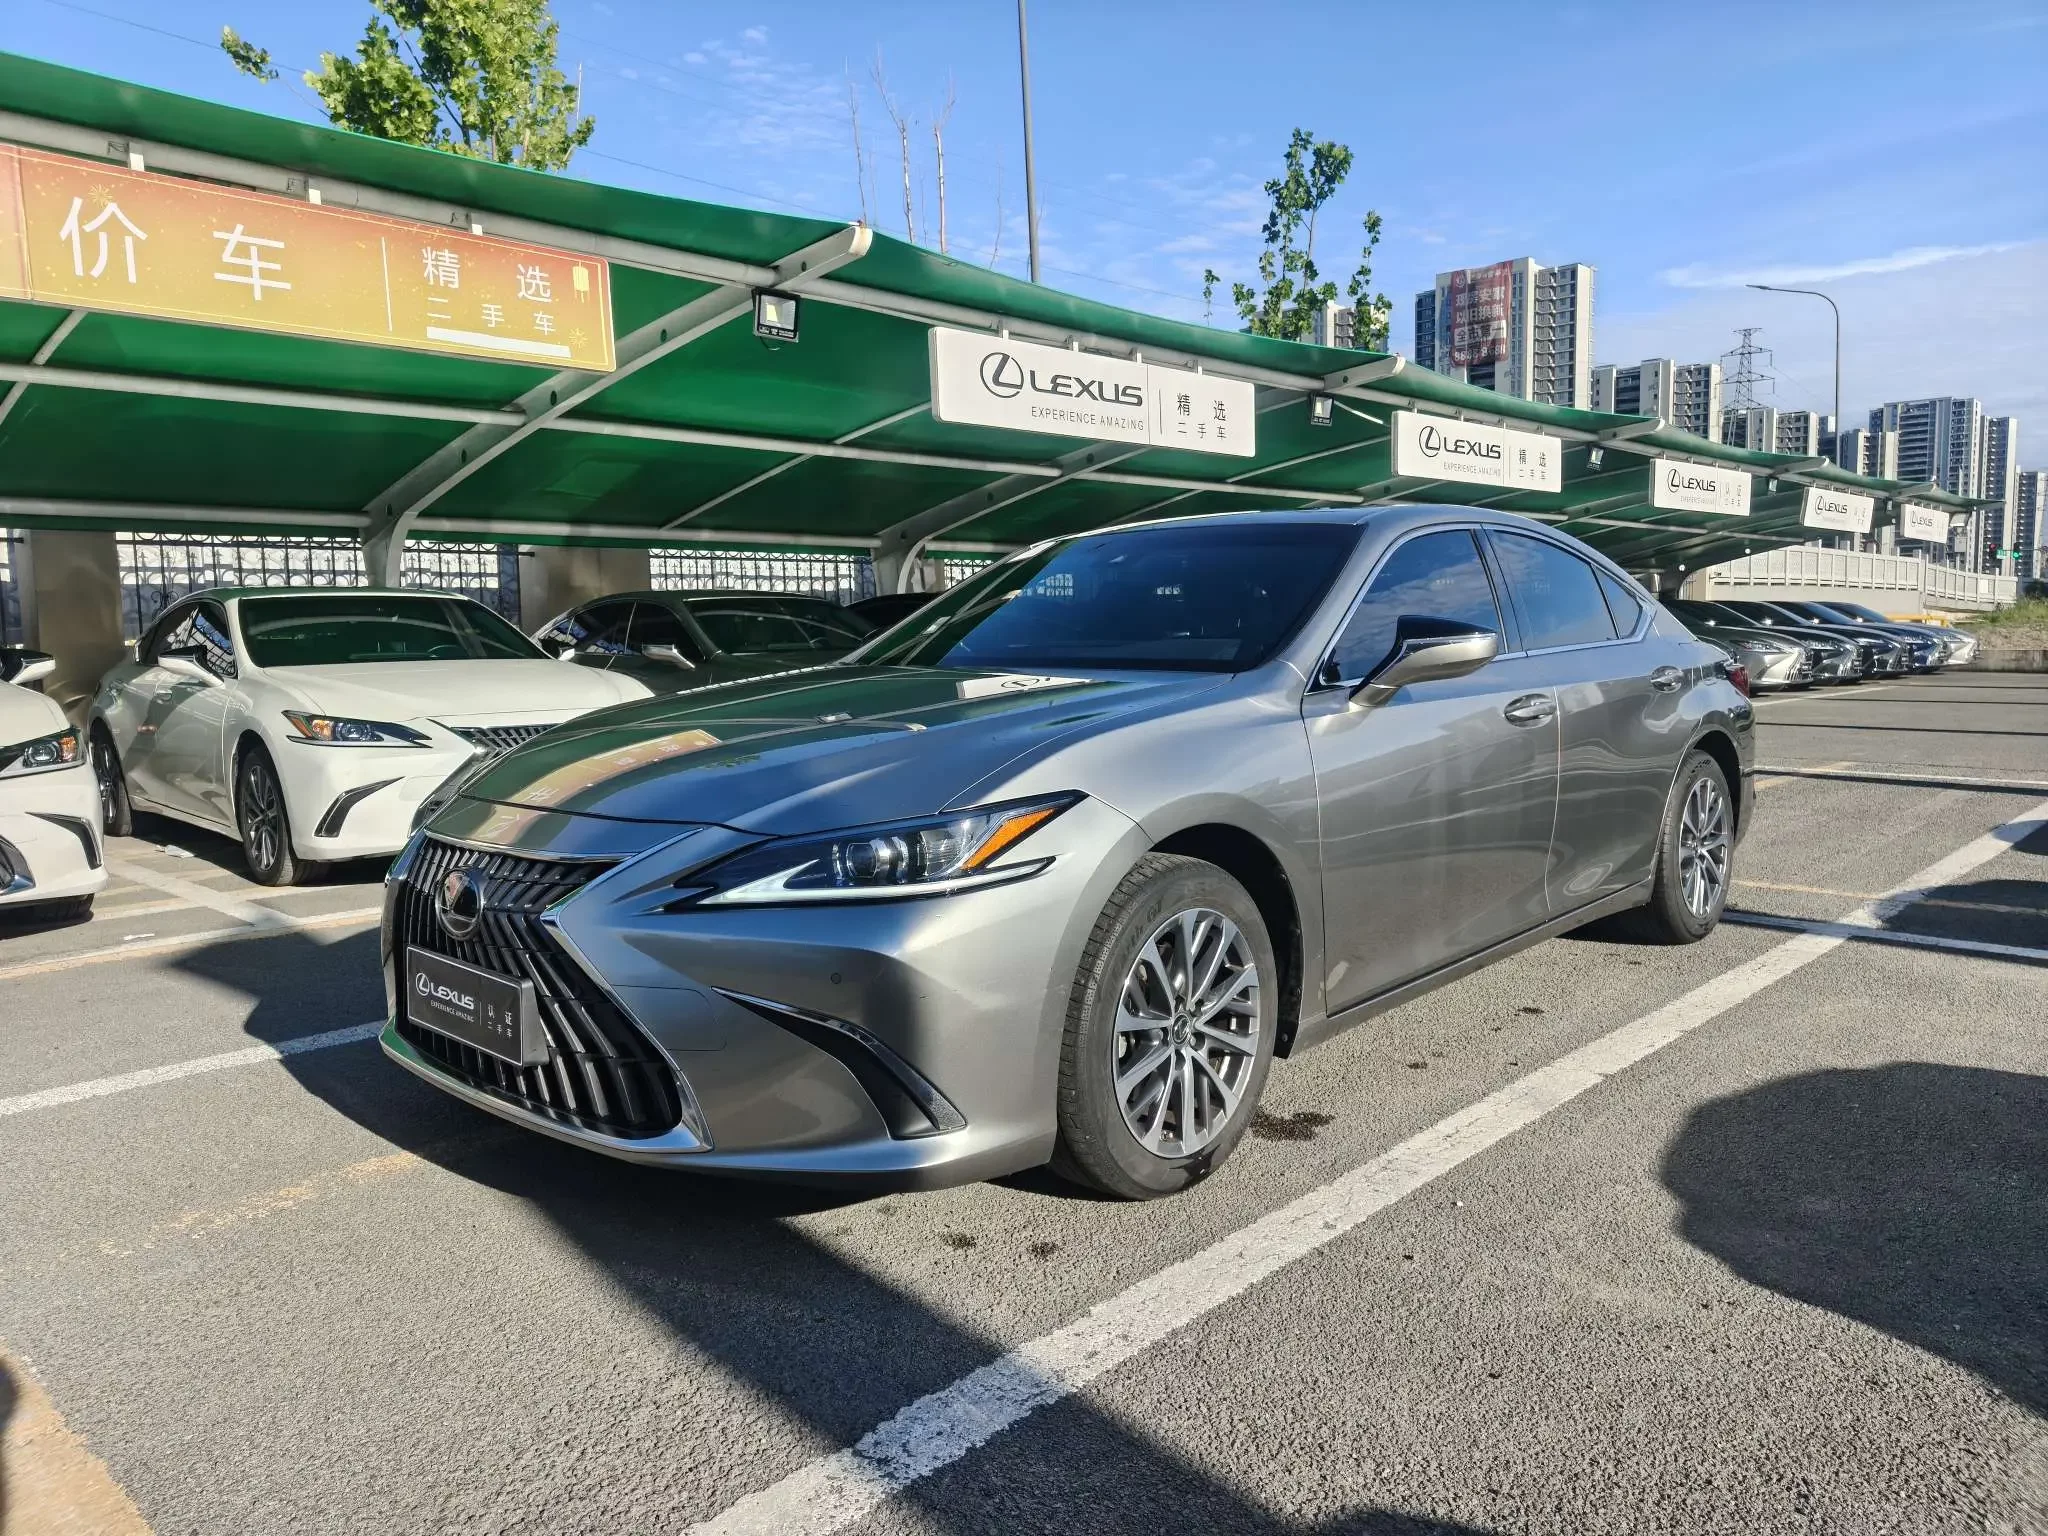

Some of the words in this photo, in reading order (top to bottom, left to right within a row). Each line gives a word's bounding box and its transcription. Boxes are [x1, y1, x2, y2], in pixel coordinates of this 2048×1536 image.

[422, 246, 553, 303] 精选
[426, 297, 556, 335] 二手车
[1029, 369, 1143, 407] LEXUS
[1031, 406, 1096, 425] EXPERIENCE
[1099, 415, 1144, 431] AMAZING
[1177, 392, 1226, 422] 精选
[1177, 422, 1227, 440] 二手车
[1443, 437, 1502, 460] LEXUS
[1681, 476, 1716, 492] LEXUS
[1824, 502, 1848, 514] LEXUS
[431, 982, 474, 1010] LEXUS
